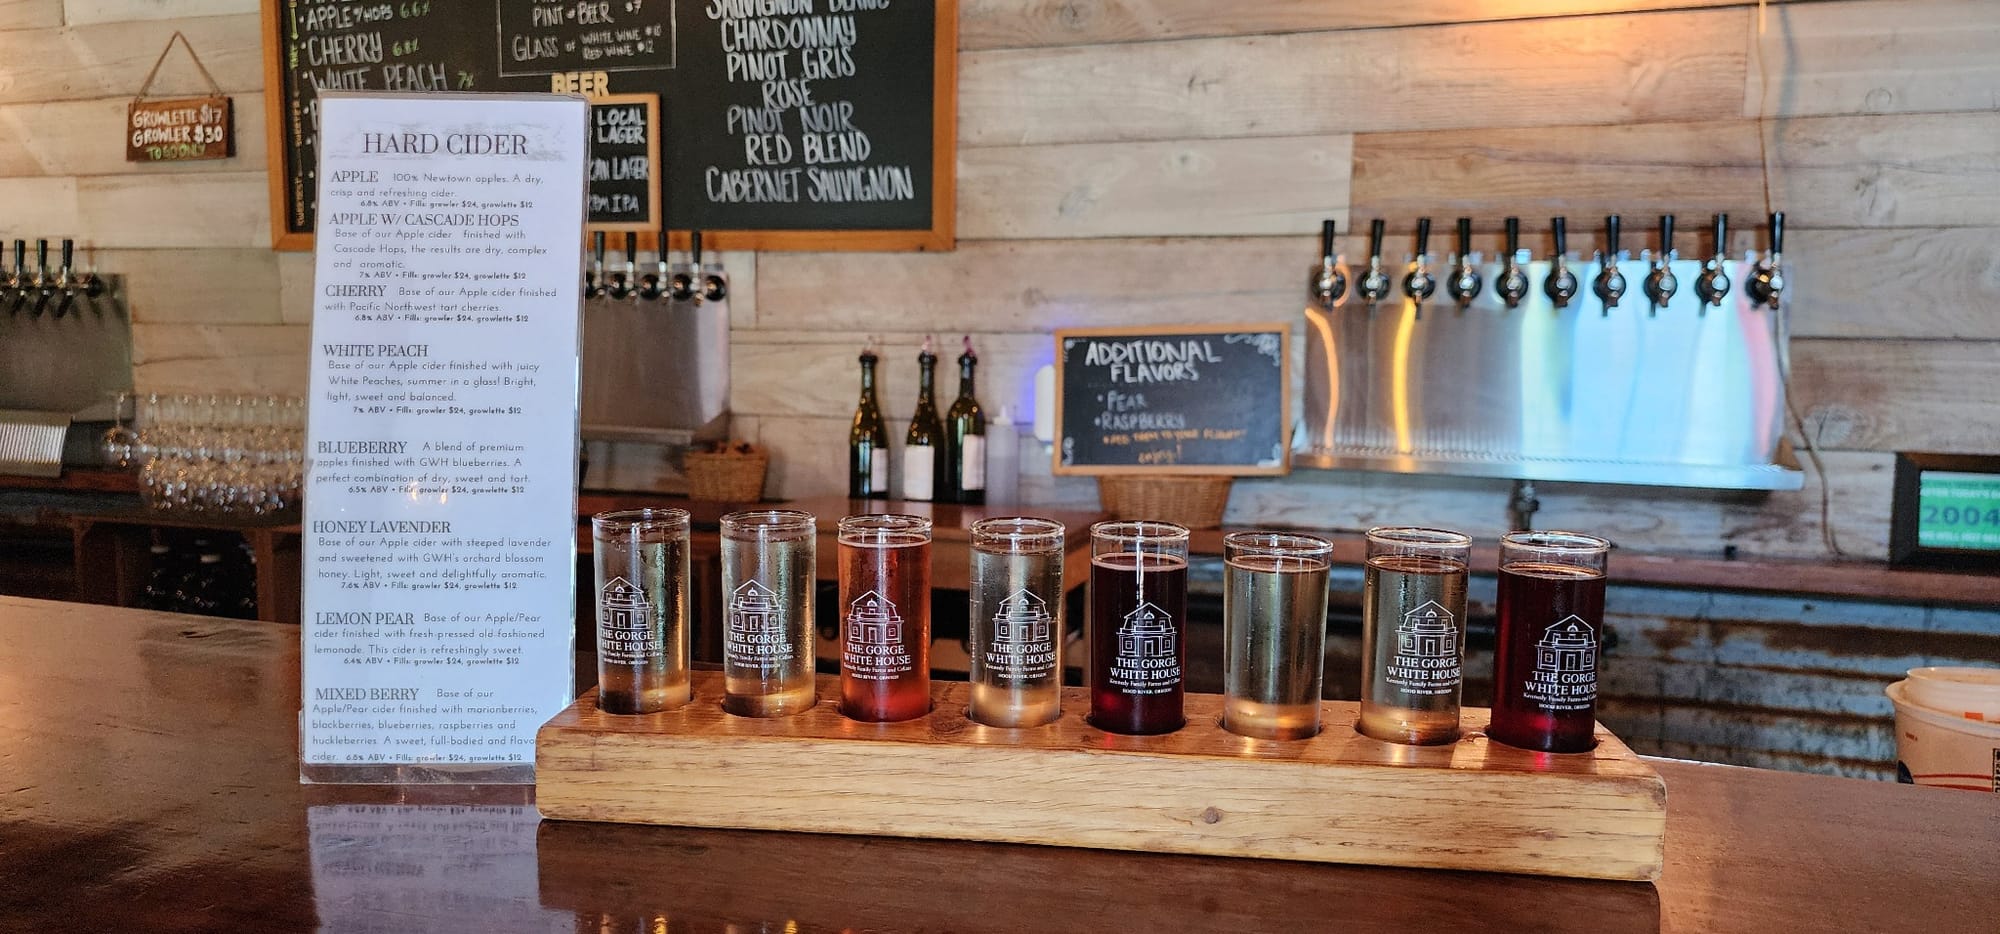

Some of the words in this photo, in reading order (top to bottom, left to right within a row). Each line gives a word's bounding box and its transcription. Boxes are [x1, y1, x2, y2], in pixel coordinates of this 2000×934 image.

[306, 6, 353, 31] APPLE
[577, 1, 614, 24] BEER
[721, 15, 857, 52] CHARDONNAY
[308, 31, 383, 66] CHERRY
[512, 34, 559, 61] GLASS
[726, 51, 788, 82] PINOT
[802, 45, 856, 80] GRIS
[309, 67, 371, 91] WHITE
[383, 63, 449, 91] PEACH
[551, 70, 610, 97] BEER
[132, 108, 197, 128] GROWLETTE
[597, 107, 646, 126] LOCAL
[727, 104, 785, 134] PINOT
[800, 101, 860, 133] NOIR
[132, 126, 191, 147] GROWLER
[193, 124, 223, 144] $30
[597, 125, 646, 144] LAGER
[364, 133, 439, 154] HARD
[446, 134, 529, 155] CIDER
[745, 133, 792, 165] RED
[802, 131, 871, 164] BLEND
[330, 170, 378, 182] APPLE
[393, 173, 418, 182] 100%
[424, 173, 471, 182] Newtown
[475, 174, 509, 184] apples.
[512, 174, 521, 182] A
[525, 174, 543, 186] dry,
[706, 166, 802, 202] CABERNET
[807, 165, 915, 202] SAUVIGNON
[329, 213, 377, 225] APPLE
[381, 214, 401, 224] W/
[405, 214, 474, 226] CASCADE
[478, 214, 519, 226] HOPS
[334, 244, 376, 255] Cascade
[380, 244, 406, 256] Hops,
[412, 244, 426, 253] the
[430, 244, 461, 254] results
[483, 243, 503, 256] dry,
[508, 245, 547, 256] complex
[326, 285, 387, 296] CHERRY
[399, 287, 420, 296] Base
[425, 286, 435, 295] of
[459, 288, 488, 298] Apple
[490, 288, 516, 296] cider
[520, 287, 556, 296] finished
[325, 301, 346, 311] with
[350, 301, 380, 311] Pacific
[385, 302, 436, 311] Northwest
[440, 302, 458, 312] tart
[462, 302, 502, 312] cherries.
[323, 344, 374, 357] WHITE
[378, 345, 428, 357] PEACH
[1085, 340, 1222, 366] ADDITIONAL
[1110, 361, 1199, 383] FLAVORS
[328, 376, 359, 384] White
[363, 376, 403, 386] Peaches,
[408, 378, 447, 386] summer
[473, 376, 500, 390] glass!
[504, 376, 536, 388] Bright,
[1107, 390, 1146, 412] PEAR
[368, 406, 386, 414] ABV
[416, 406, 446, 416] growler
[508, 406, 521, 414] $12
[1101, 411, 1186, 430] RASPBERRY
[318, 442, 407, 454] BLUEBERRY
[423, 442, 430, 451] A
[436, 441, 462, 451] blend
[466, 442, 476, 451] of
[480, 444, 524, 453] premium
[1922, 505, 2000, 527] 2004
[314, 521, 367, 534] HONEY
[370, 521, 452, 534] LAVENDER
[316, 612, 372, 625] LEMON
[376, 612, 414, 625] PEAR
[424, 613, 446, 622] Base
[451, 612, 460, 622] of
[485, 612, 540, 624] Apple/Pear
[615, 631, 654, 640] GORGE
[729, 631, 746, 642] THE
[747, 634, 786, 643] GORGE
[624, 641, 662, 651] HOUSE
[757, 644, 793, 655] HOUSE
[847, 642, 864, 654] THE
[866, 645, 905, 655] GORGE
[992, 642, 1013, 653] THE
[1016, 642, 1052, 654] GORGE
[844, 652, 873, 666] WHITE
[875, 655, 911, 666] HOUSE
[986, 652, 1024, 665] WHITE
[1026, 651, 1056, 664] HOUSE
[1115, 656, 1139, 669] THE
[1141, 656, 1177, 669] GORGE
[1394, 655, 1419, 667] THE
[1421, 656, 1457, 668] GORGE
[1110, 666, 1149, 680] WHITE
[1151, 665, 1180, 680] HOUSE
[1387, 665, 1429, 680] WHITE
[1431, 666, 1460, 680] HOUSE
[1532, 671, 1558, 683] THE
[1561, 672, 1595, 684] GORGE
[316, 688, 366, 700] MIXED
[370, 688, 419, 700] BERRY
[437, 688, 459, 697] Base
[464, 688, 474, 697] of
[1525, 681, 1569, 695] WHITE
[1572, 682, 1597, 695] HOUSE
